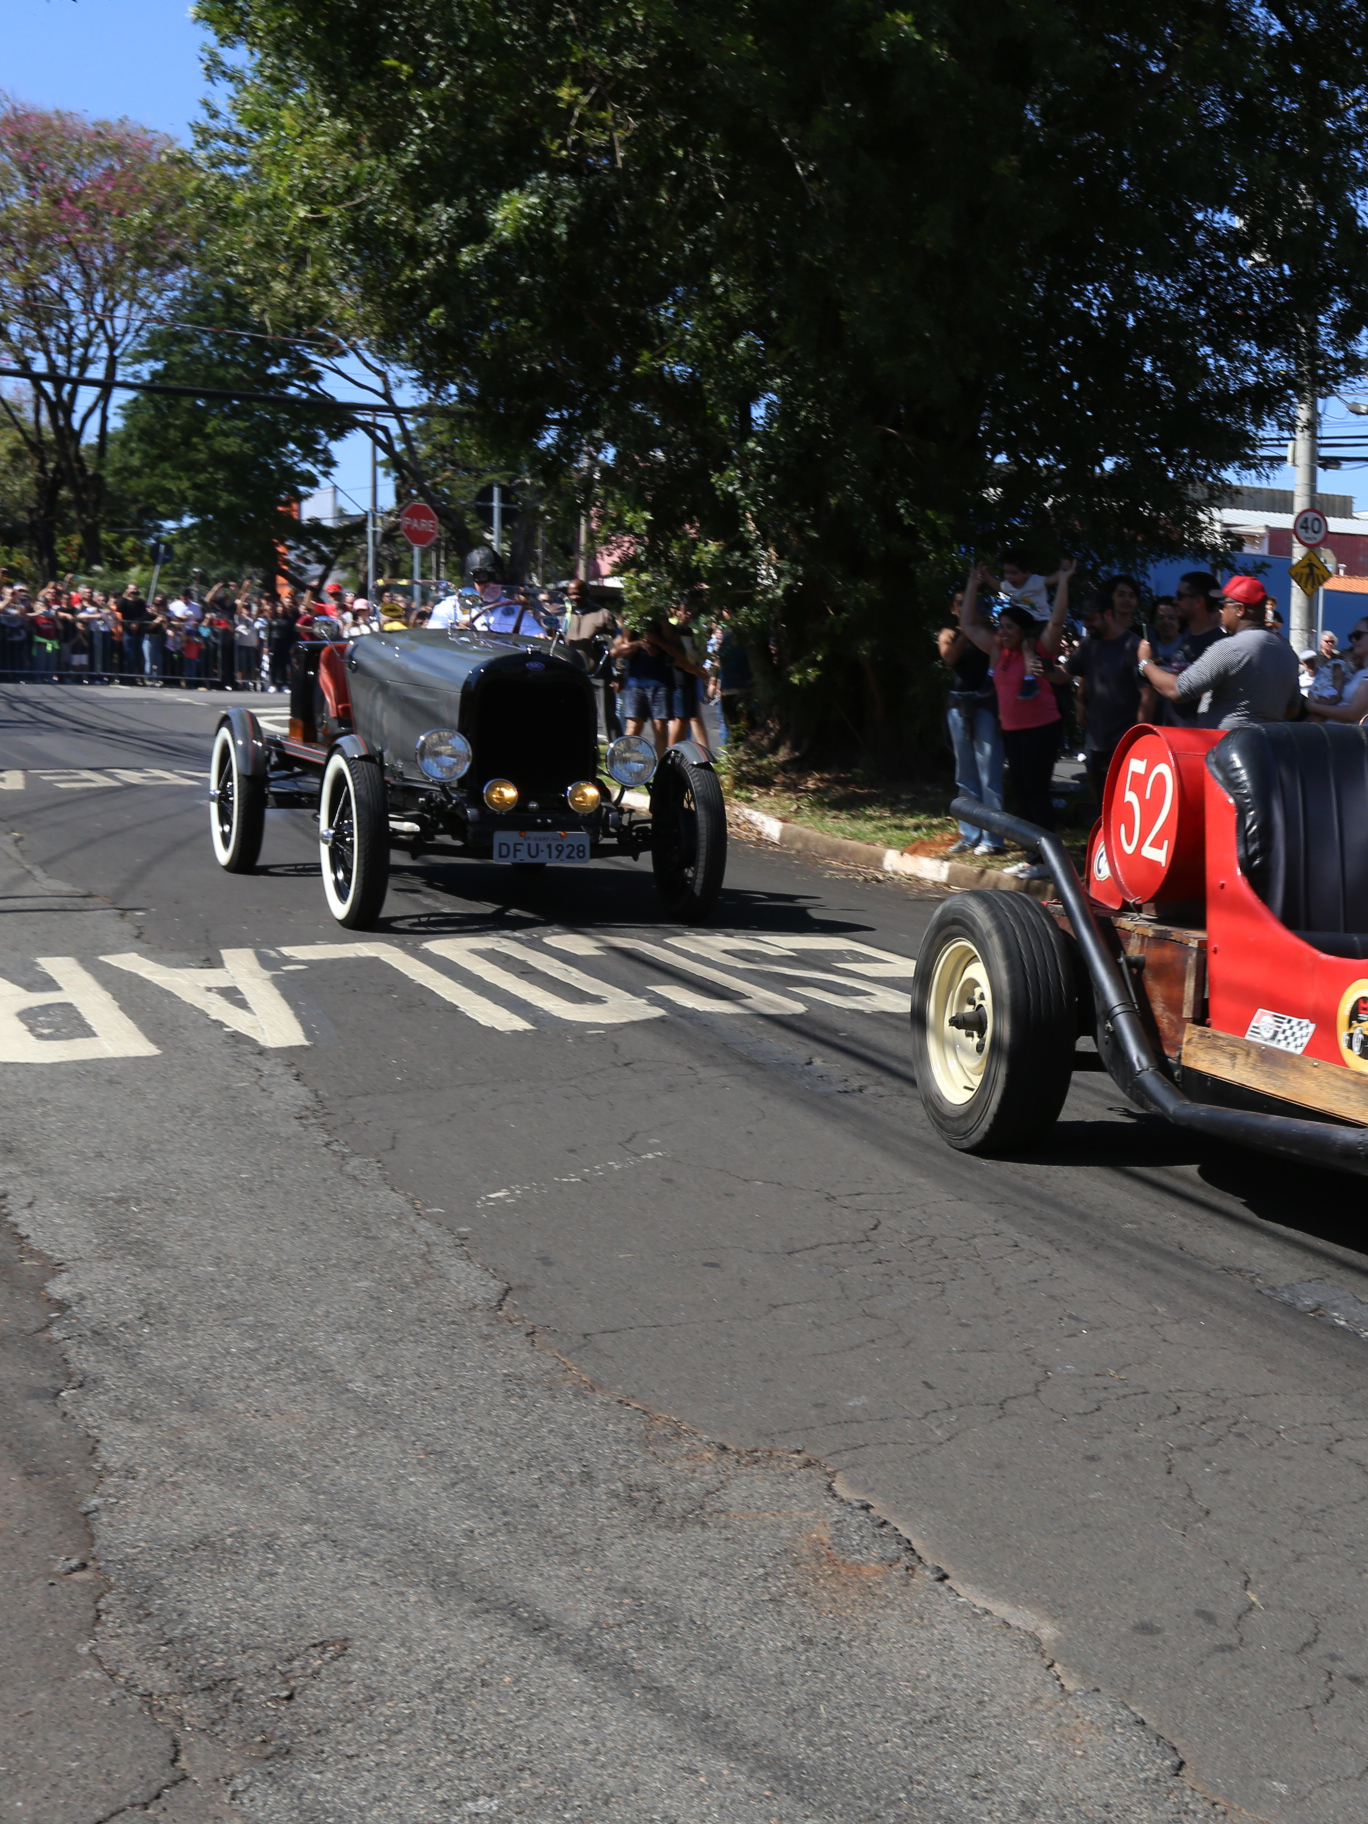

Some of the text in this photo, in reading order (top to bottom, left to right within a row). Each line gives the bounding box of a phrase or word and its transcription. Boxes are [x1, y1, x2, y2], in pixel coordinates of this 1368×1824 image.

[403, 517, 435, 532] PARE
[1299, 516, 1321, 534] 40
[1119, 757, 1174, 867] 52
